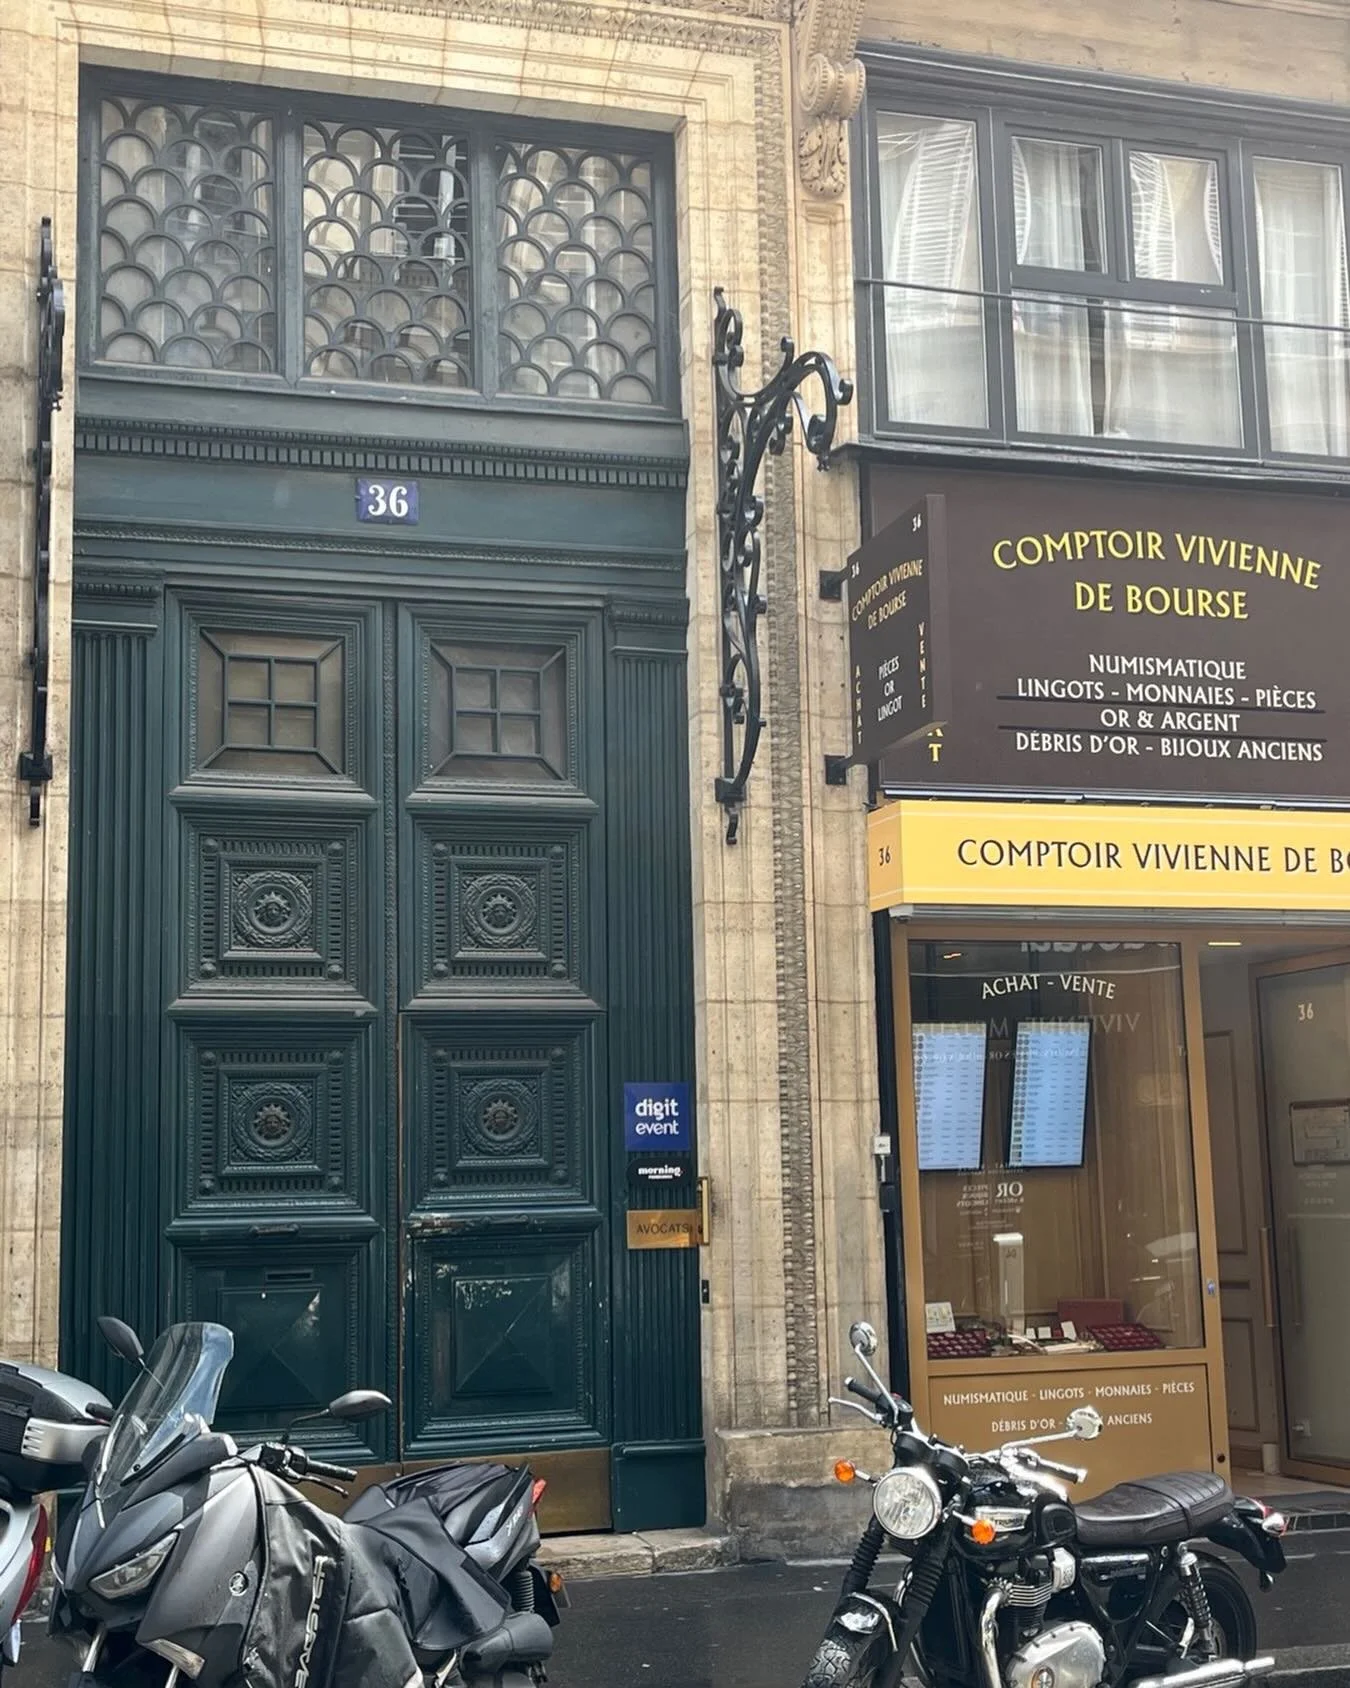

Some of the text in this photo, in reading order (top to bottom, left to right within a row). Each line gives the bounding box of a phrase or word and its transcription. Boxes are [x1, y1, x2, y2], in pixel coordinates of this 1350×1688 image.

[367, 484, 409, 517] 36
[912, 513, 922, 532] 36
[851, 562, 860, 578] 36
[993, 530, 1321, 589] COMPTOIR VIVIENNE
[852, 560, 923, 621] COMPTOIR VIVIENNE
[1075, 581, 1249, 619] DE BOURSE
[867, 590, 907, 630] DE BOURSE
[878, 655, 900, 681] PIÈCES
[918, 621, 927, 708] VENTE
[1089, 654, 1247, 680] NUMISMATIQUE
[884, 679, 896, 697] OR
[1017, 678, 1105, 700] LINGOTS
[1126, 682, 1235, 706] MONNAIES
[1255, 684, 1317, 709] PIÈCES
[855, 664, 863, 744] ACHAT
[877, 695, 903, 722] LINGOT
[1100, 708, 1241, 733] OR & ARGENT
[1016, 729, 1083, 753] DÉBRIS
[1090, 734, 1140, 756] D'OR
[1161, 737, 1232, 759] BIJOUX
[1237, 740, 1323, 762] ANCIENS
[878, 845, 892, 867] 36
[957, 838, 1350, 874] COMPTOIR VIVIENNE DE B
[981, 974, 1041, 1000] ACHAT
[1058, 974, 1117, 1000] VENTE
[1298, 1003, 1315, 1021] 36
[635, 1098, 680, 1121] digit
[635, 1119, 680, 1135] event
[638, 1164, 682, 1177] morning
[636, 1223, 690, 1234] AVOCATS
[943, 1391, 1029, 1406] NUMISMATIQUE
[1039, 1386, 1085, 1401] LINGOTS
[1095, 1383, 1152, 1398] MONNAIES
[1162, 1381, 1196, 1395] PIÈCES
[991, 1418, 1027, 1433] DÉBRIS
[1030, 1416, 1056, 1431] D'OR
[1107, 1412, 1153, 1426] ANCIENS
